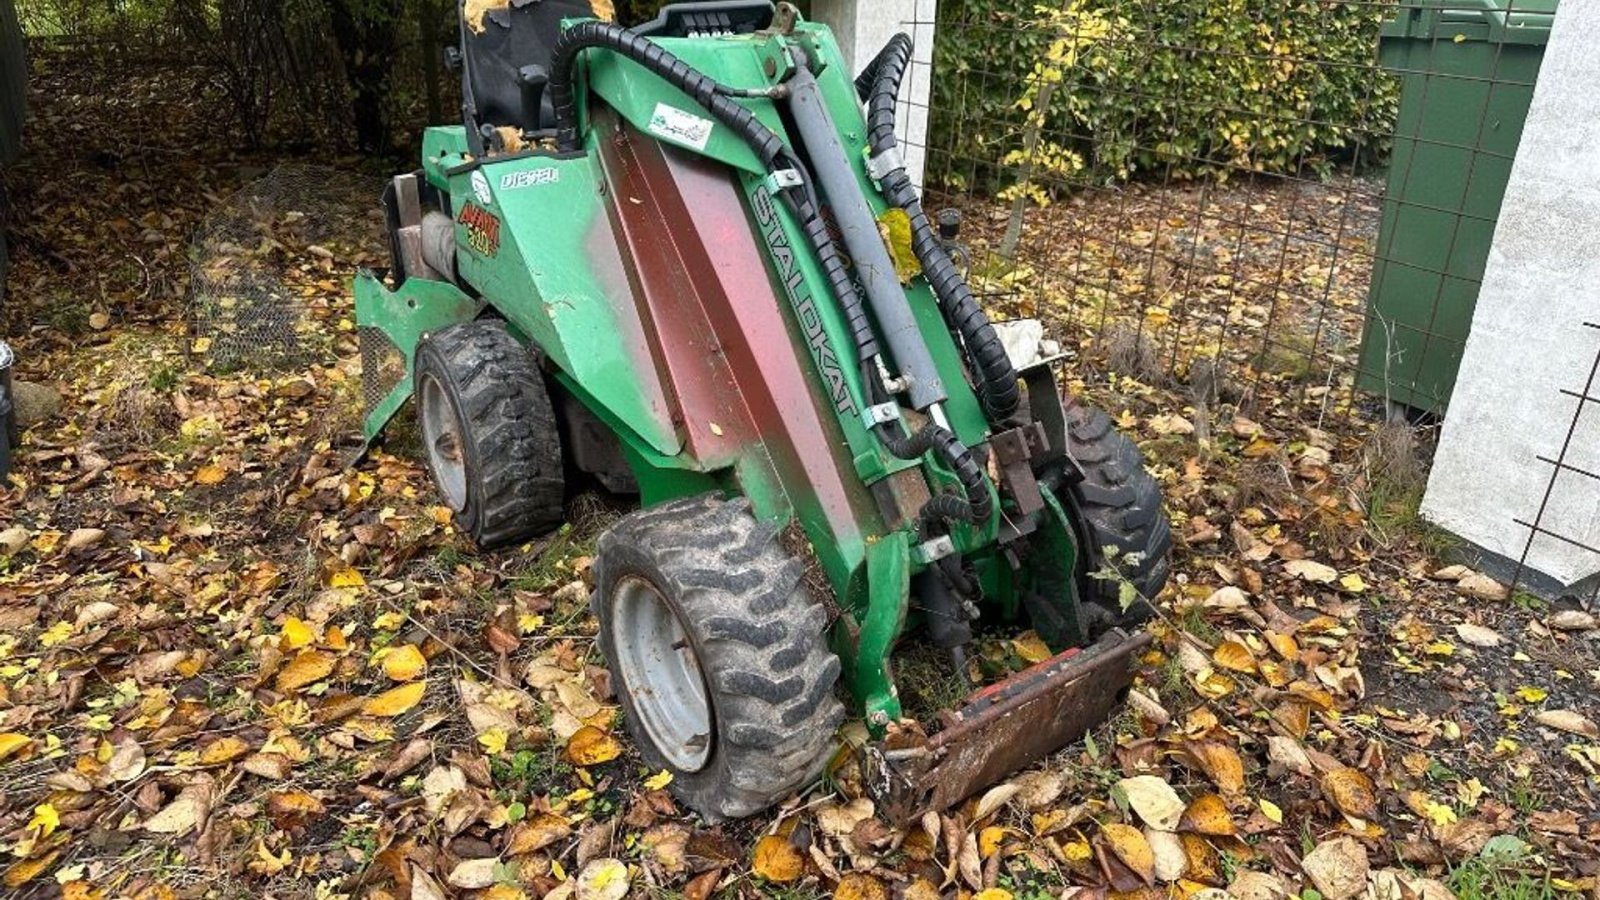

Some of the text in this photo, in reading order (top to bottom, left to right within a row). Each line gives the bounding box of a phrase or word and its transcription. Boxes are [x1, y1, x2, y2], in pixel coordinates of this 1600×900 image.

[502, 168, 558, 189] DIESEL
[458, 201, 500, 250] AVANT
[752, 184, 859, 418] STALDKAT
